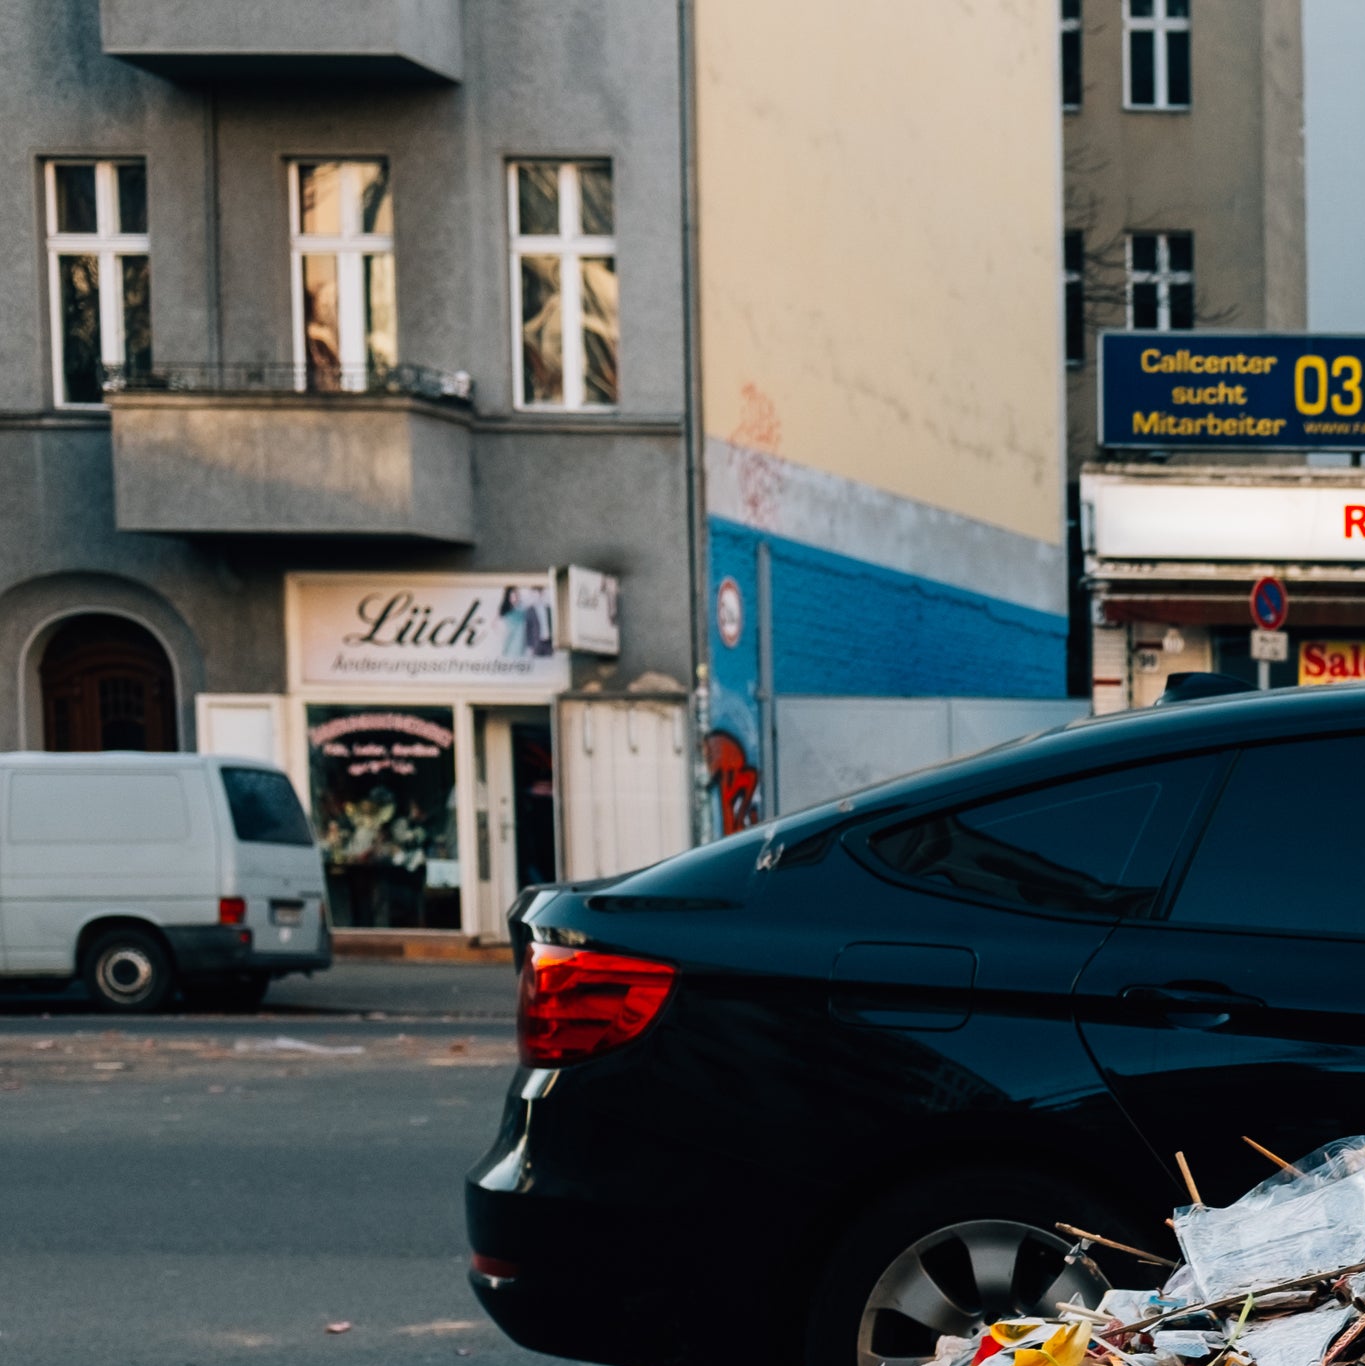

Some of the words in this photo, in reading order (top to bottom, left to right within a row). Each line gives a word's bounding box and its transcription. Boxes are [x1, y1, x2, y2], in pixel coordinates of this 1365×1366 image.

[1140, 348, 1278, 375] Callcenter
[1171, 380, 1247, 405] sucht
[1132, 411, 1286, 436] Mitarbeiter
[343, 590, 485, 648] Lück
